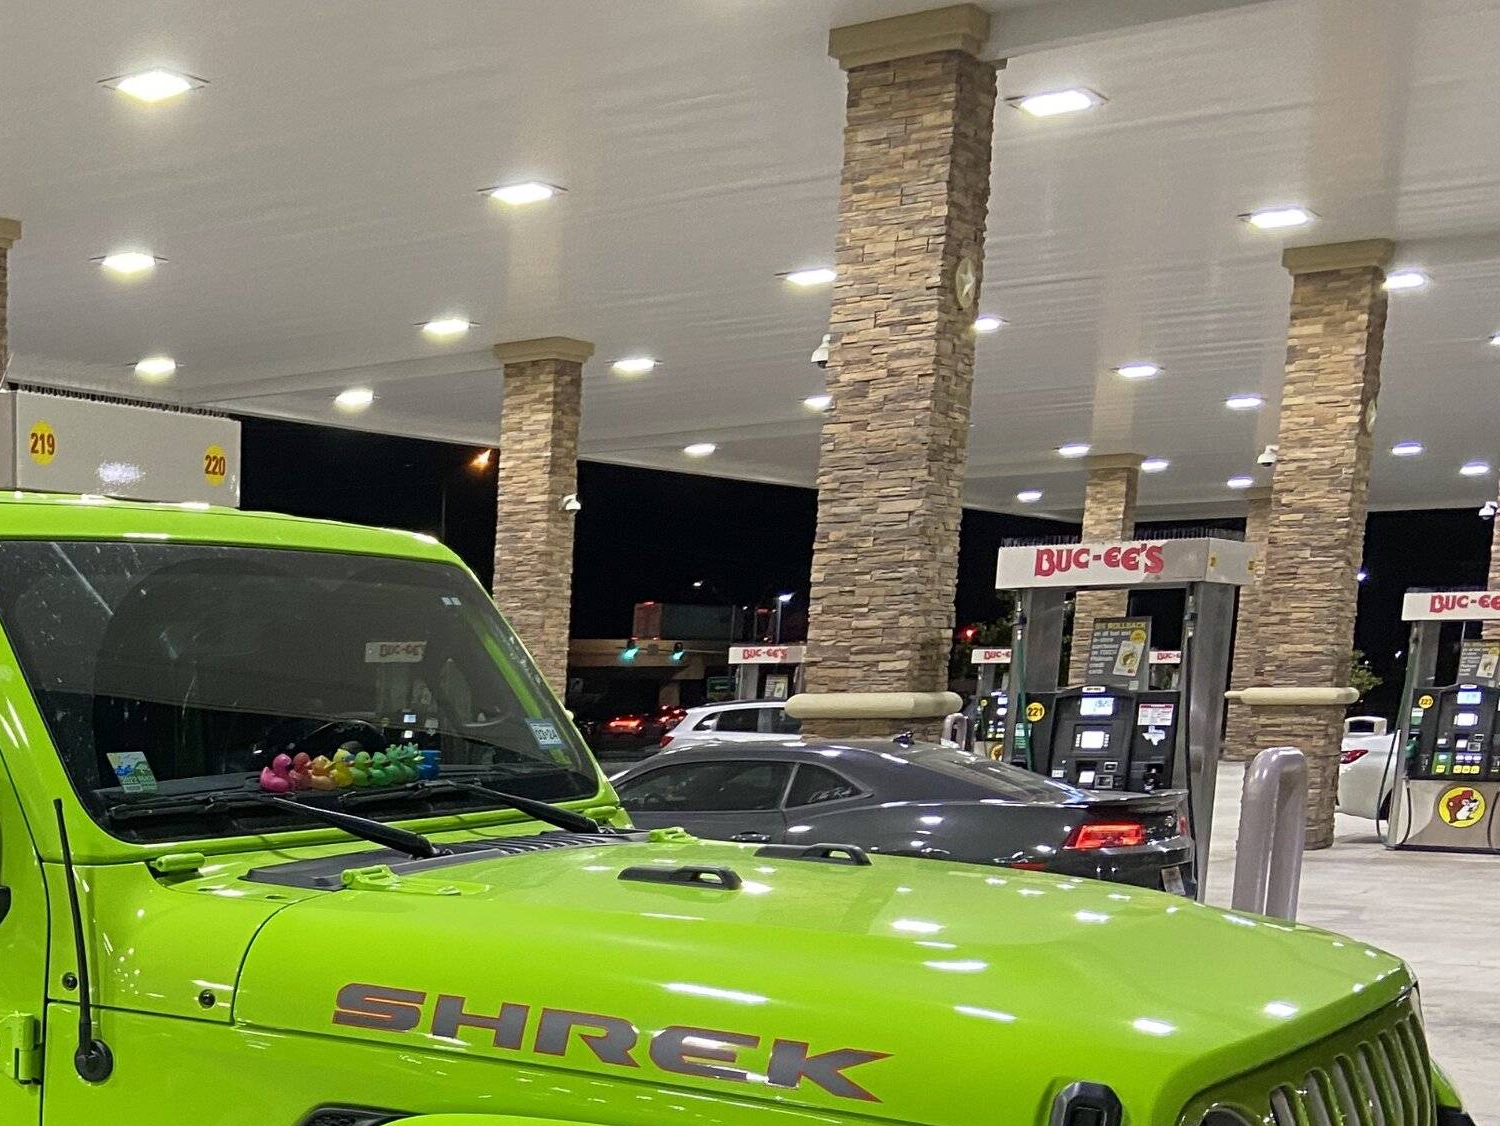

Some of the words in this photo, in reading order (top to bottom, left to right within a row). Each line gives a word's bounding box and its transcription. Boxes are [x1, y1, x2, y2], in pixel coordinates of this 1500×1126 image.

[29, 431, 56, 456] 219
[204, 454, 226, 477] 220
[1033, 543, 1165, 578] BUC-EE'S
[1027, 706, 1043, 717] 221
[331, 982, 895, 1104] SHREK
